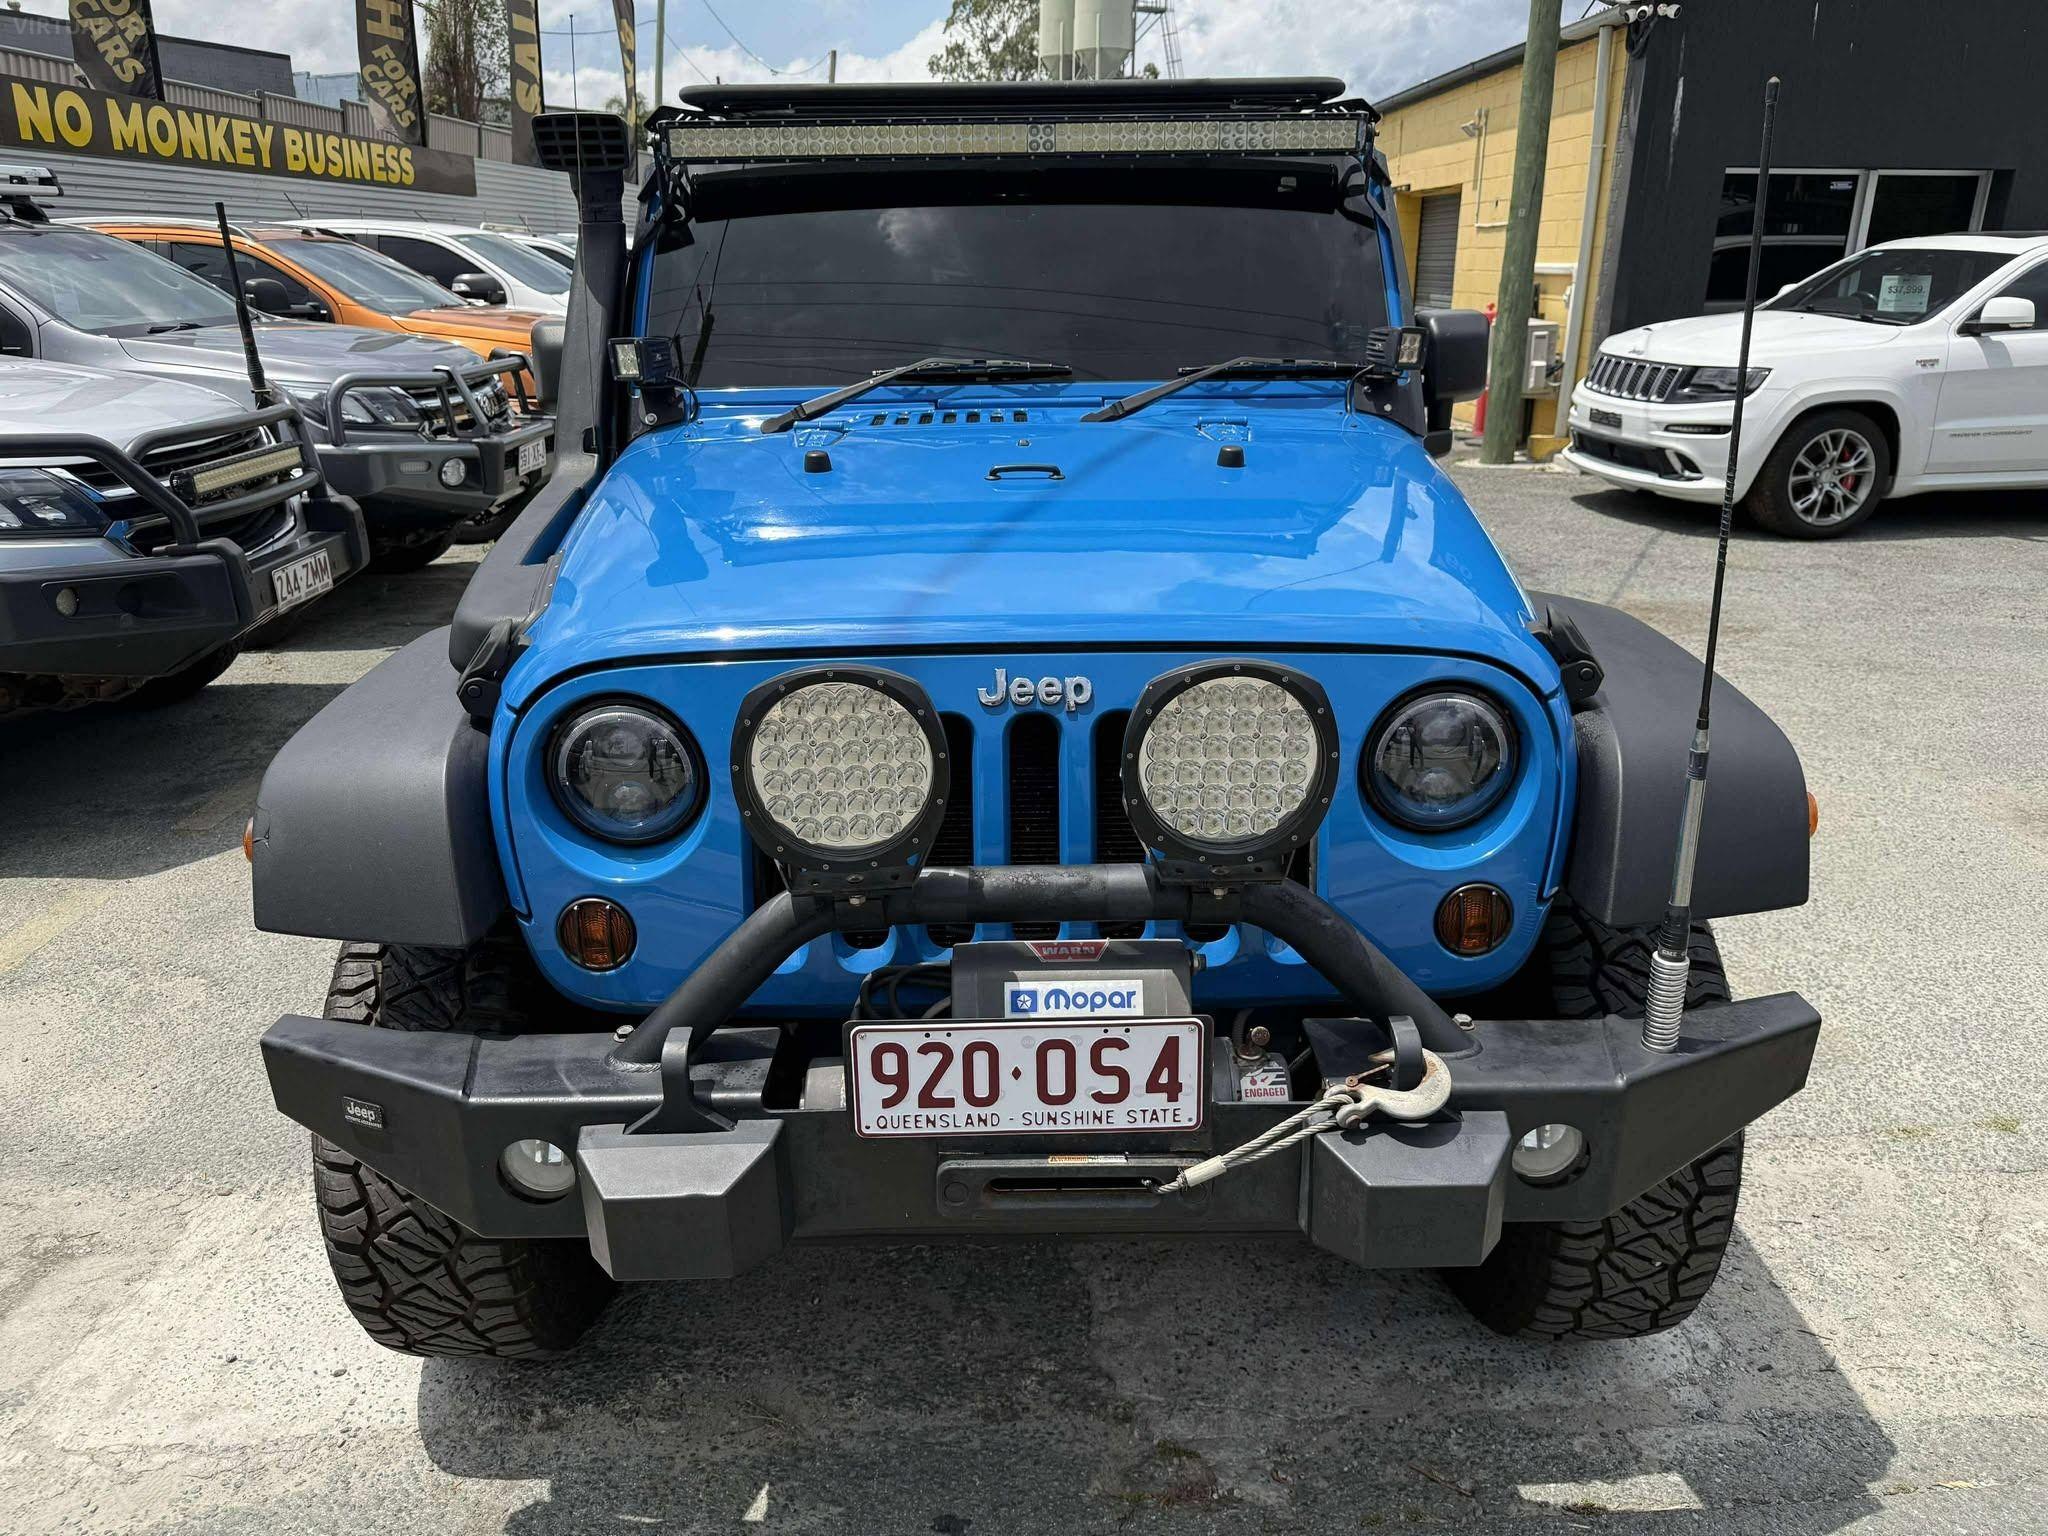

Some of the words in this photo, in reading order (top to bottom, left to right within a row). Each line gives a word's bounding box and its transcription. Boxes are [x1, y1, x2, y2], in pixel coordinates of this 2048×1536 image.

[69, 0, 147, 84] CARS
[100, 0, 147, 43] OR
[371, 44, 417, 99] FOR
[511, 0, 543, 114] SAL
[362, 64, 416, 128] CARS
[11, 82, 93, 147] NO
[106, 98, 274, 168] MONKEY
[283, 128, 415, 185] BUSINESS
[977, 667, 1093, 711] Jeep
[1041, 945, 1095, 955] WARN
[1043, 988, 1137, 1012] Mopar
[346, 1101, 376, 1122] Jeep
[1244, 1086, 1286, 1098] ENGAGED
[876, 1112, 1000, 1130] QUEENSLAND
[1022, 1109, 1115, 1126] SUNSHINE
[1127, 1107, 1182, 1124] STATE
